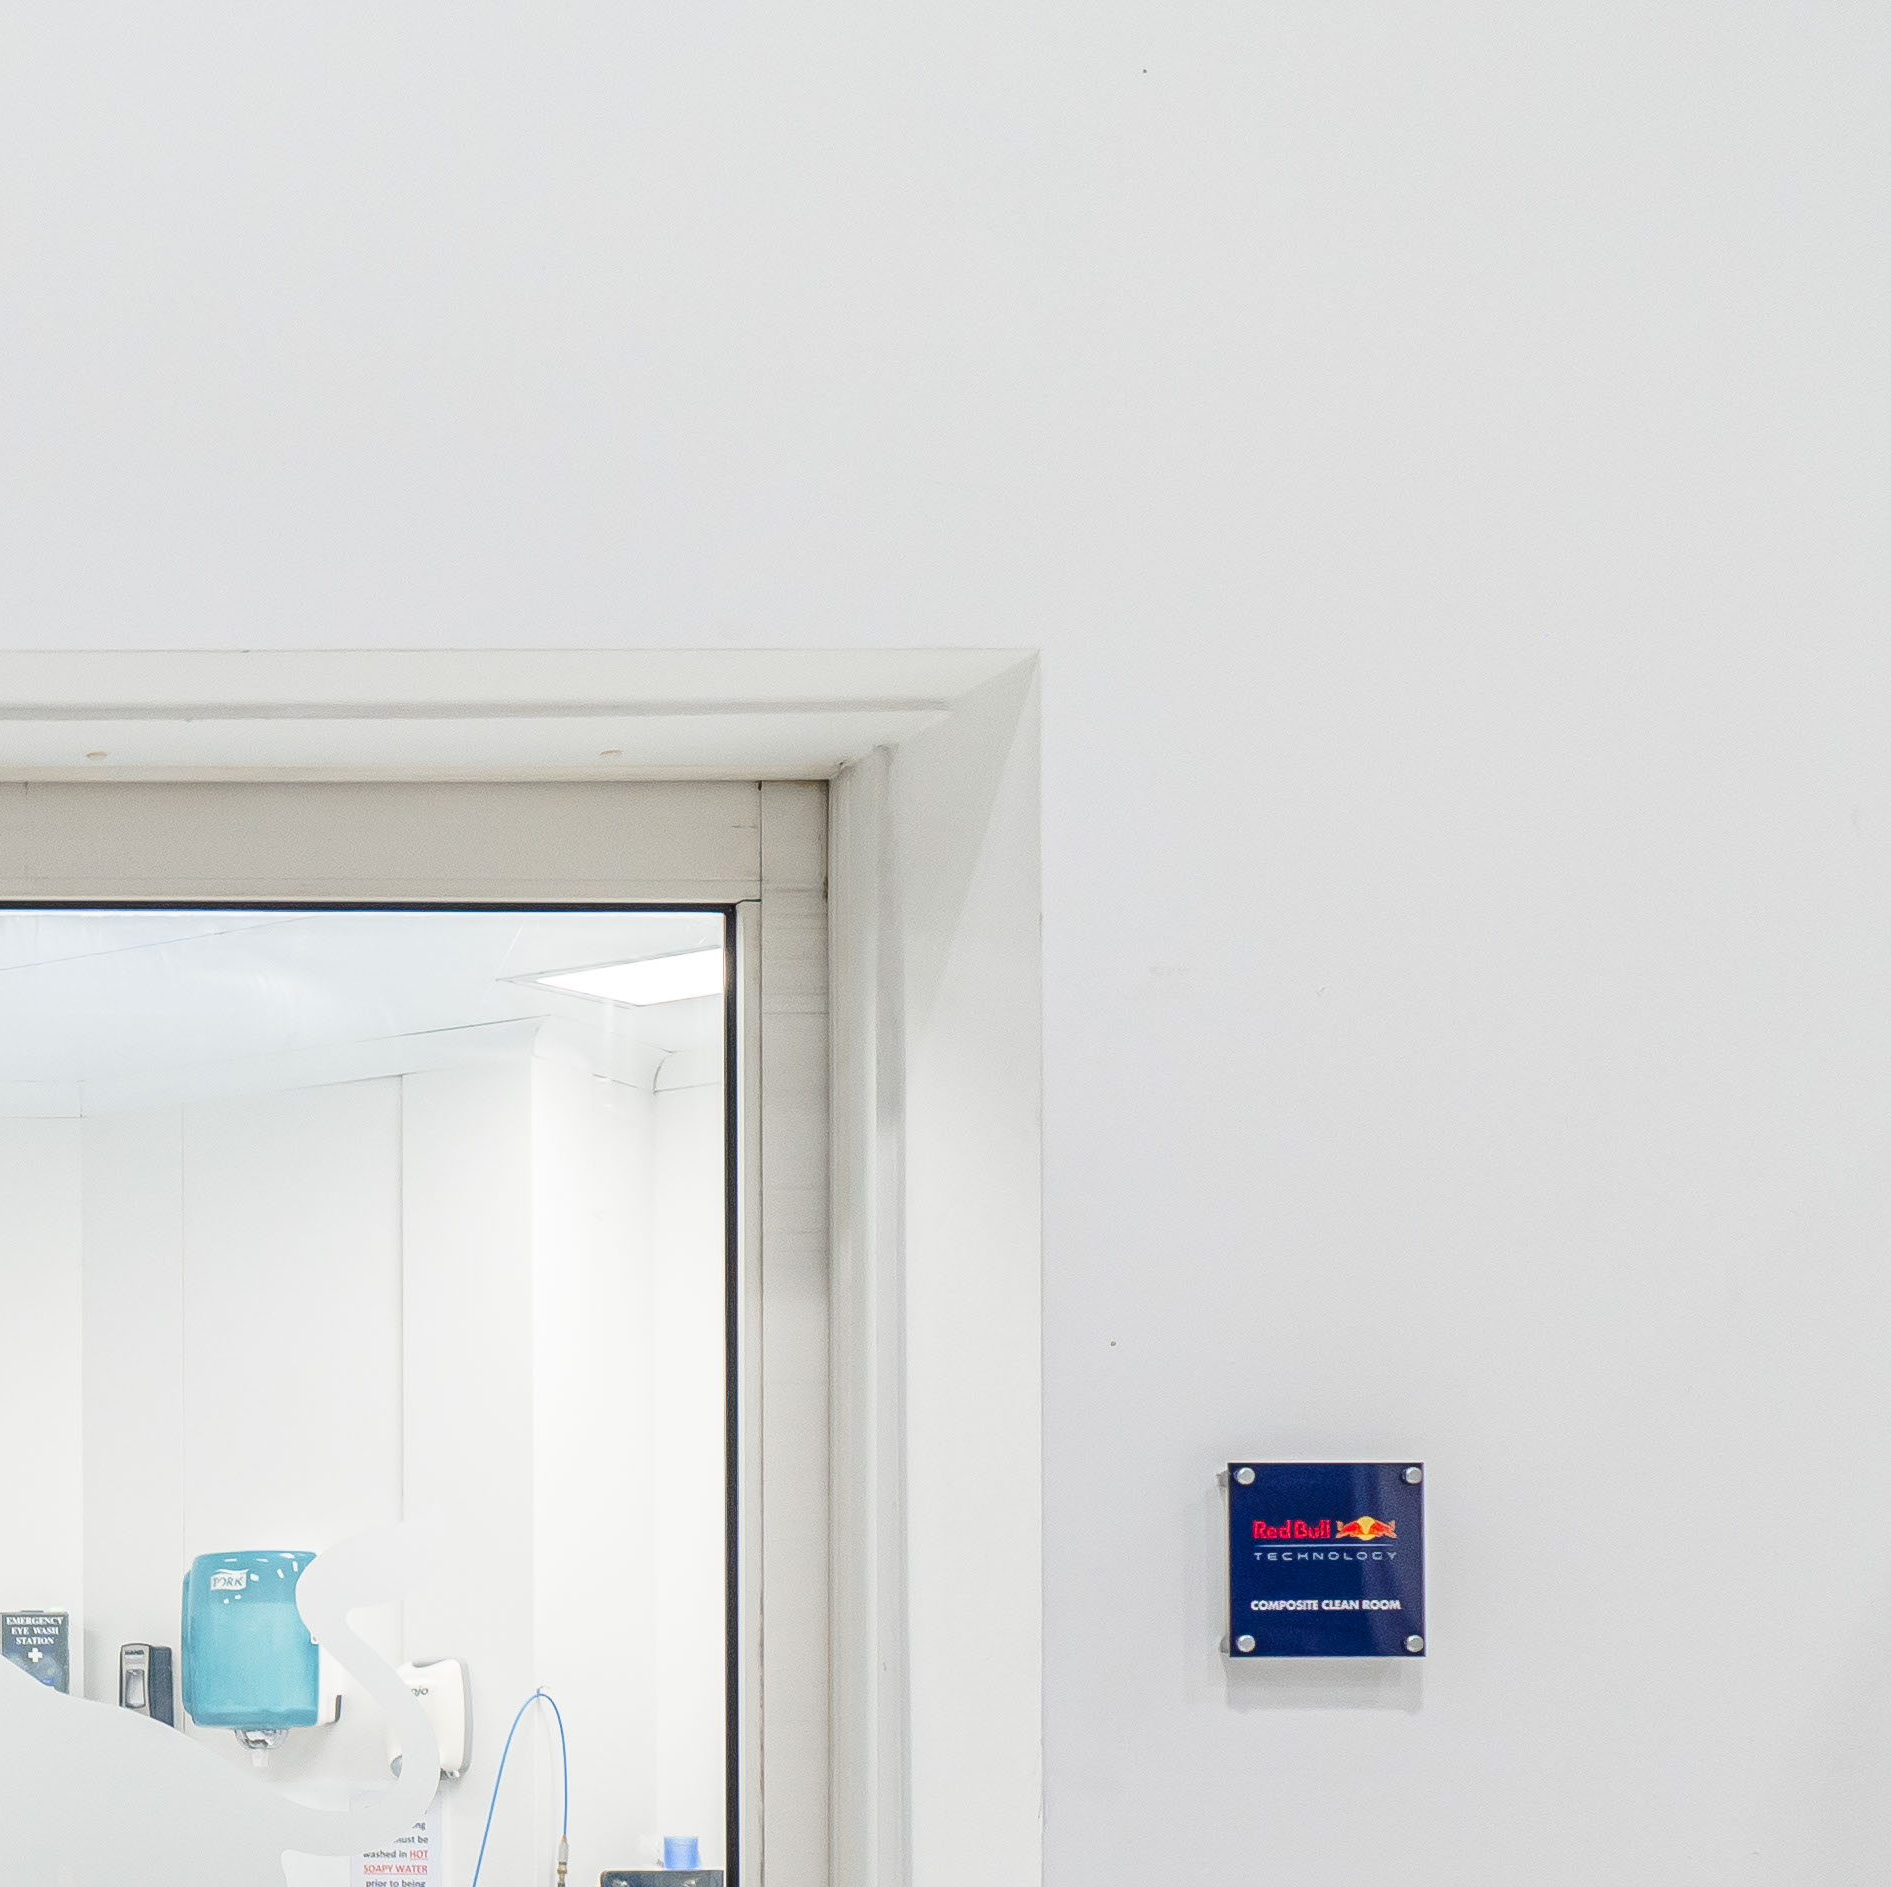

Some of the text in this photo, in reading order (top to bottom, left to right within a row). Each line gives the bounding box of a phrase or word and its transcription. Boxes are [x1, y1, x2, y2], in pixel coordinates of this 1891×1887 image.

[1252, 1519, 1331, 1539] Red Bull
[1253, 1551, 1398, 1561] TECHNOLOGY
[1250, 1599, 1402, 1611] COMPOSITE CLEAN ROOM
[5, 1616, 64, 1626] EMERGENCY
[11, 1626, 60, 1635] EYE WASH
[15, 1636, 55, 1645] STATION
[417, 1835, 429, 1844] be
[363, 1849, 428, 1859] washed in HOT
[363, 1864, 428, 1874] SOAPY WATER
[390, 1880, 400, 1887] to
